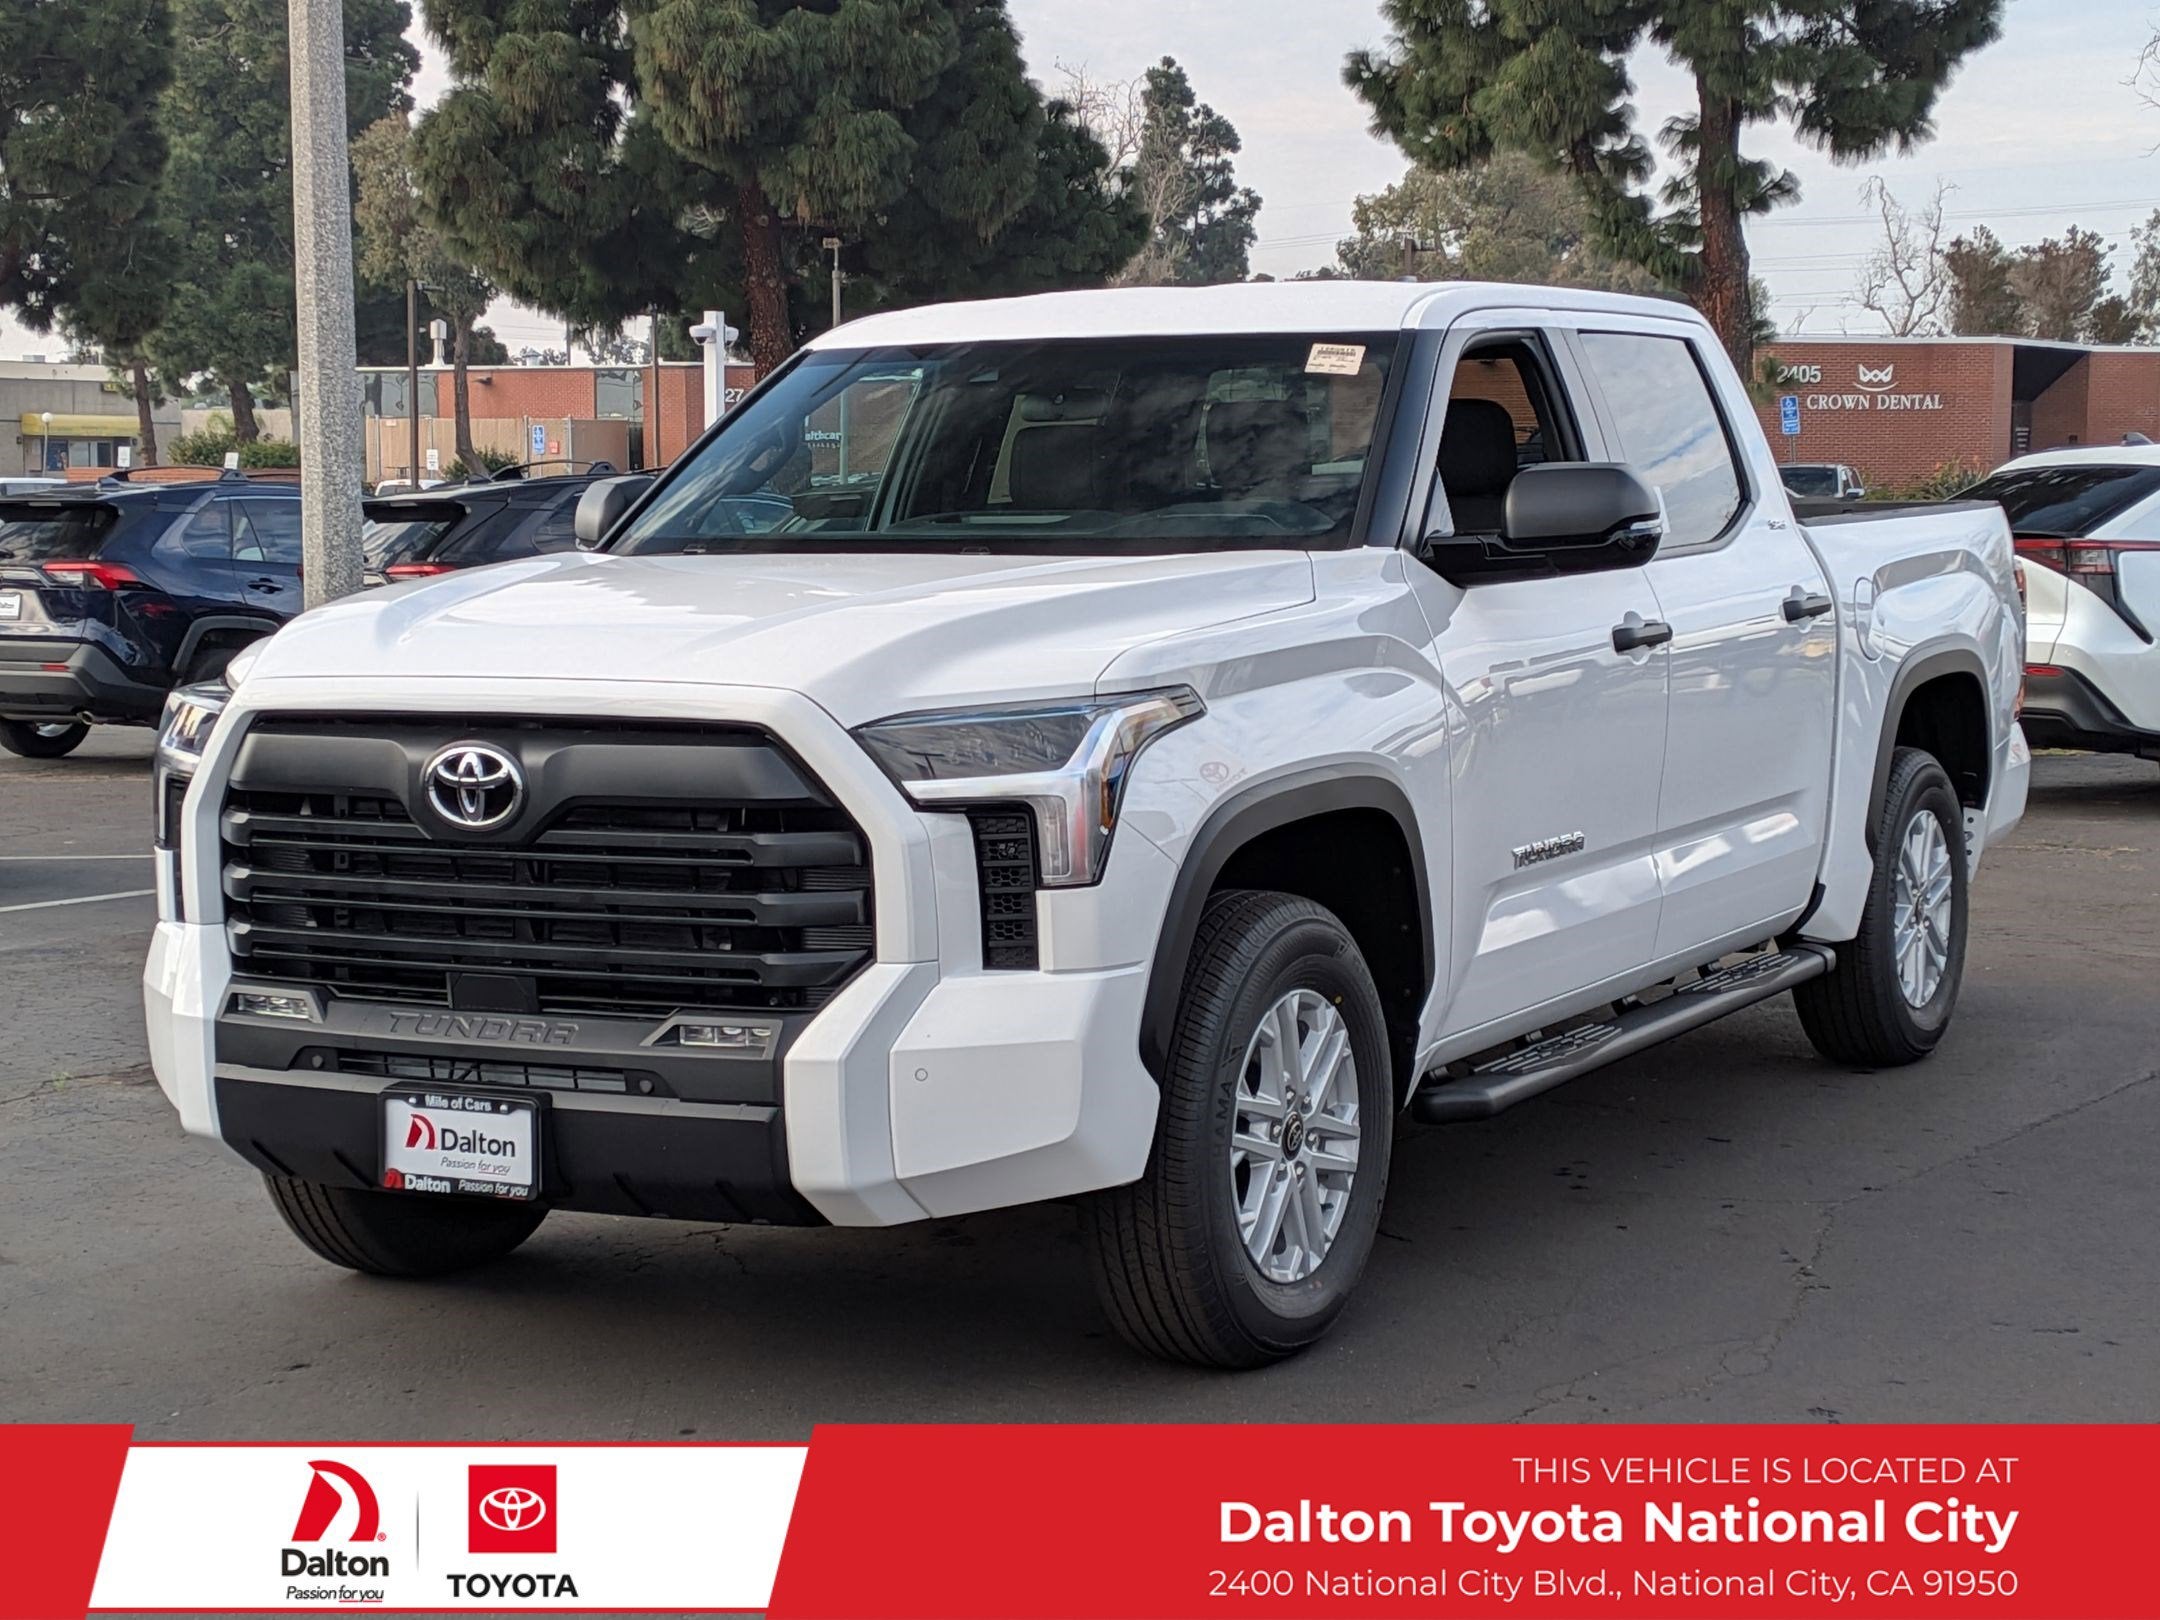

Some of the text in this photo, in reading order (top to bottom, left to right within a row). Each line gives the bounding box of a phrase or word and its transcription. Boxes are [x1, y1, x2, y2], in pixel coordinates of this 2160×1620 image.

[1776, 365, 1822, 384] 2405
[1806, 394, 1943, 410] CROWN DENTAL
[1511, 831, 1585, 870] TUNDRA
[390, 1011, 579, 1044] TUNDRA
[424, 1094, 492, 1111] Mile of Cars
[440, 1127, 516, 1157] Dalton
[440, 1156, 511, 1176] Passion for you
[404, 1174, 529, 1197] Dalton Passion for you
